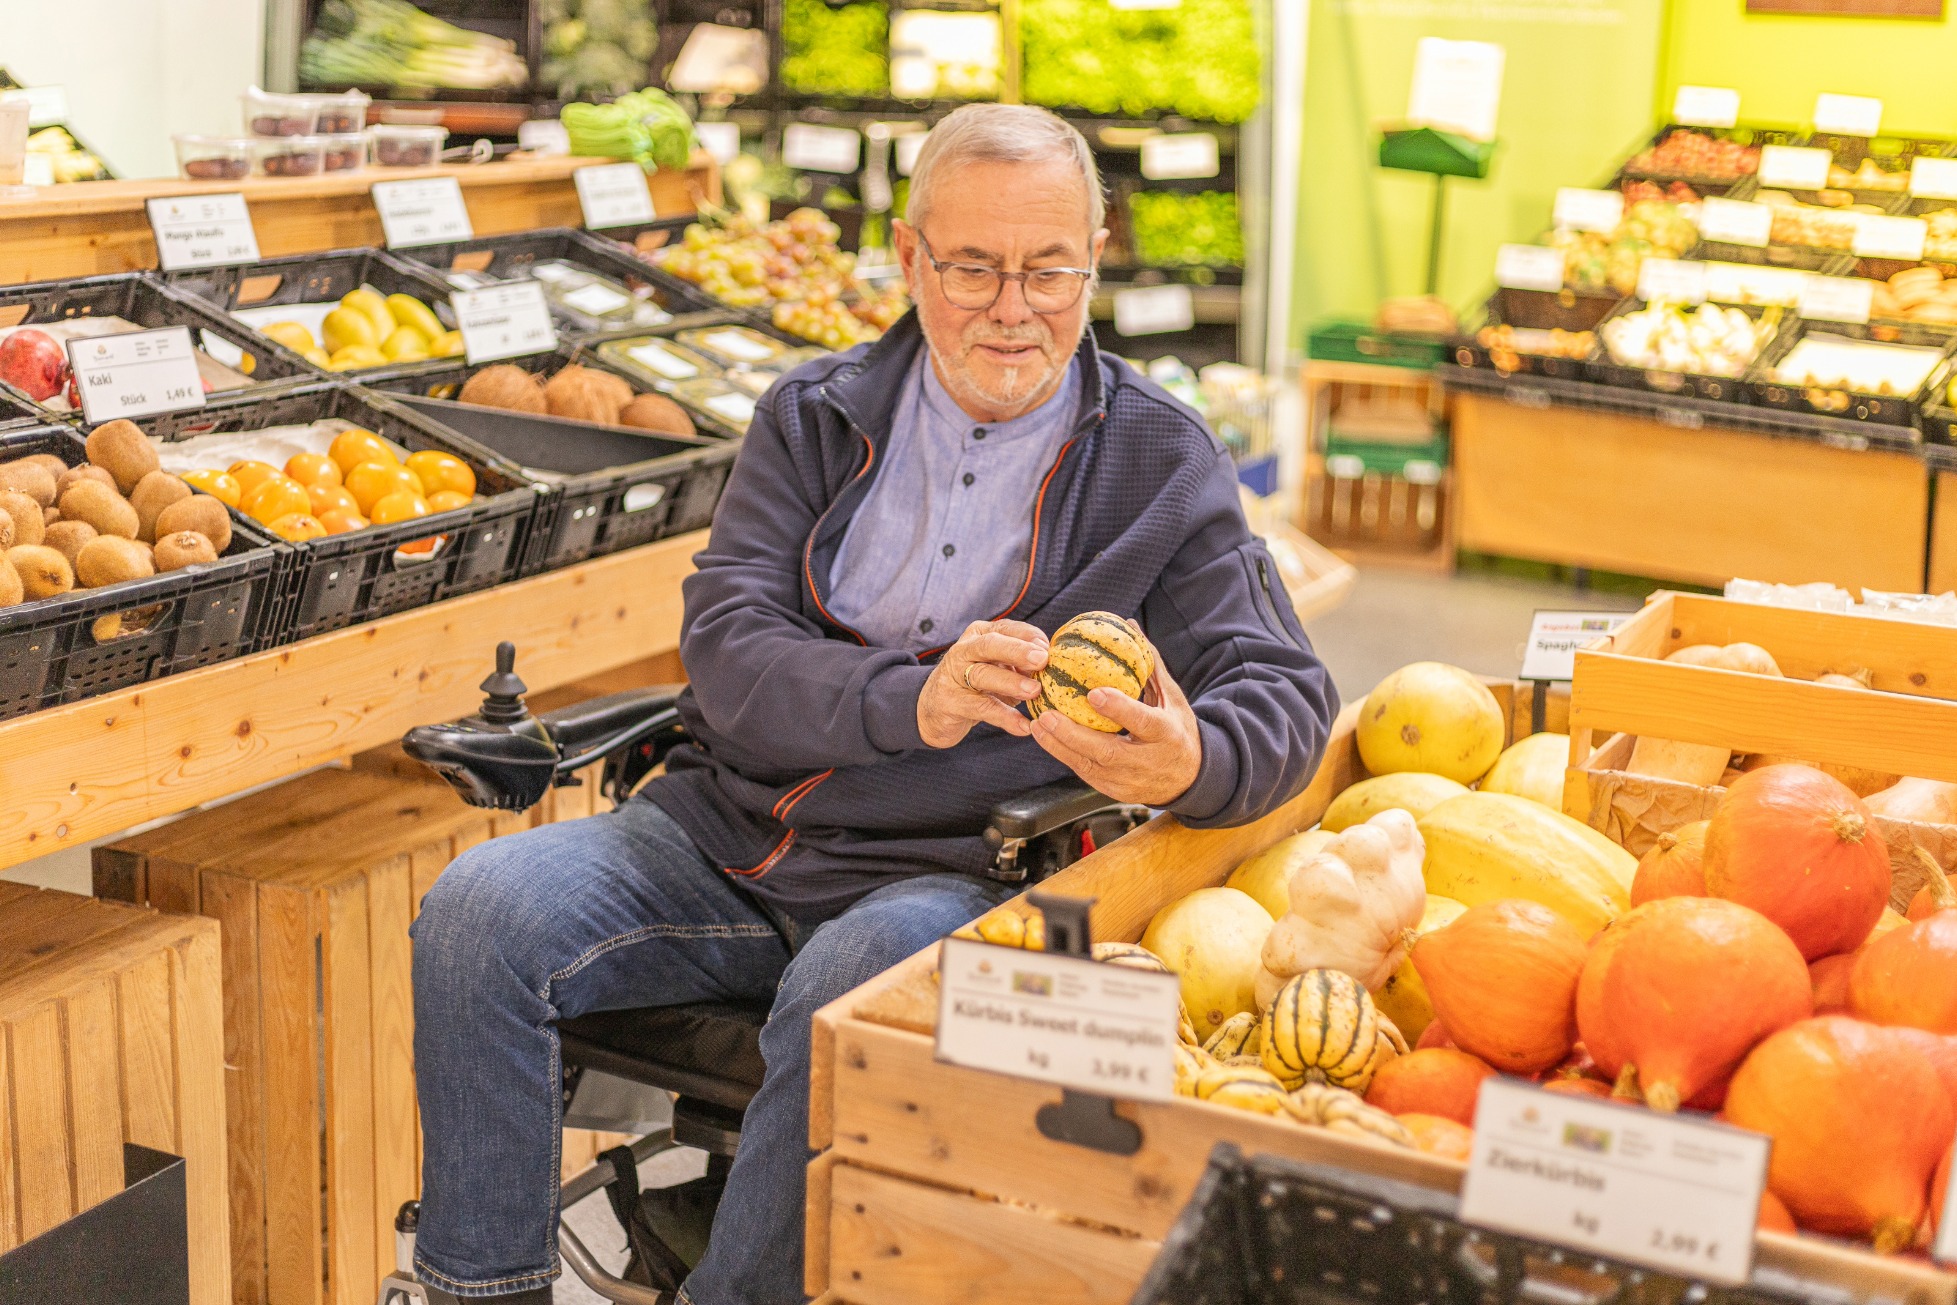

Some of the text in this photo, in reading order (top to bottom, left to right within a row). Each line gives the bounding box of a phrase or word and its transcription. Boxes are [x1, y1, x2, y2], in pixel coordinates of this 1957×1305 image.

[88, 373, 113, 387] Kaki
[120, 393, 147, 406] Stück
[953, 1000, 1014, 1025] Kürbis
[1018, 1010, 1079, 1035] Sweet
[1027, 1048, 1050, 1070] kg
[1487, 1150, 1607, 1192] Zierkürbis
[1573, 1210, 1600, 1235] kg
